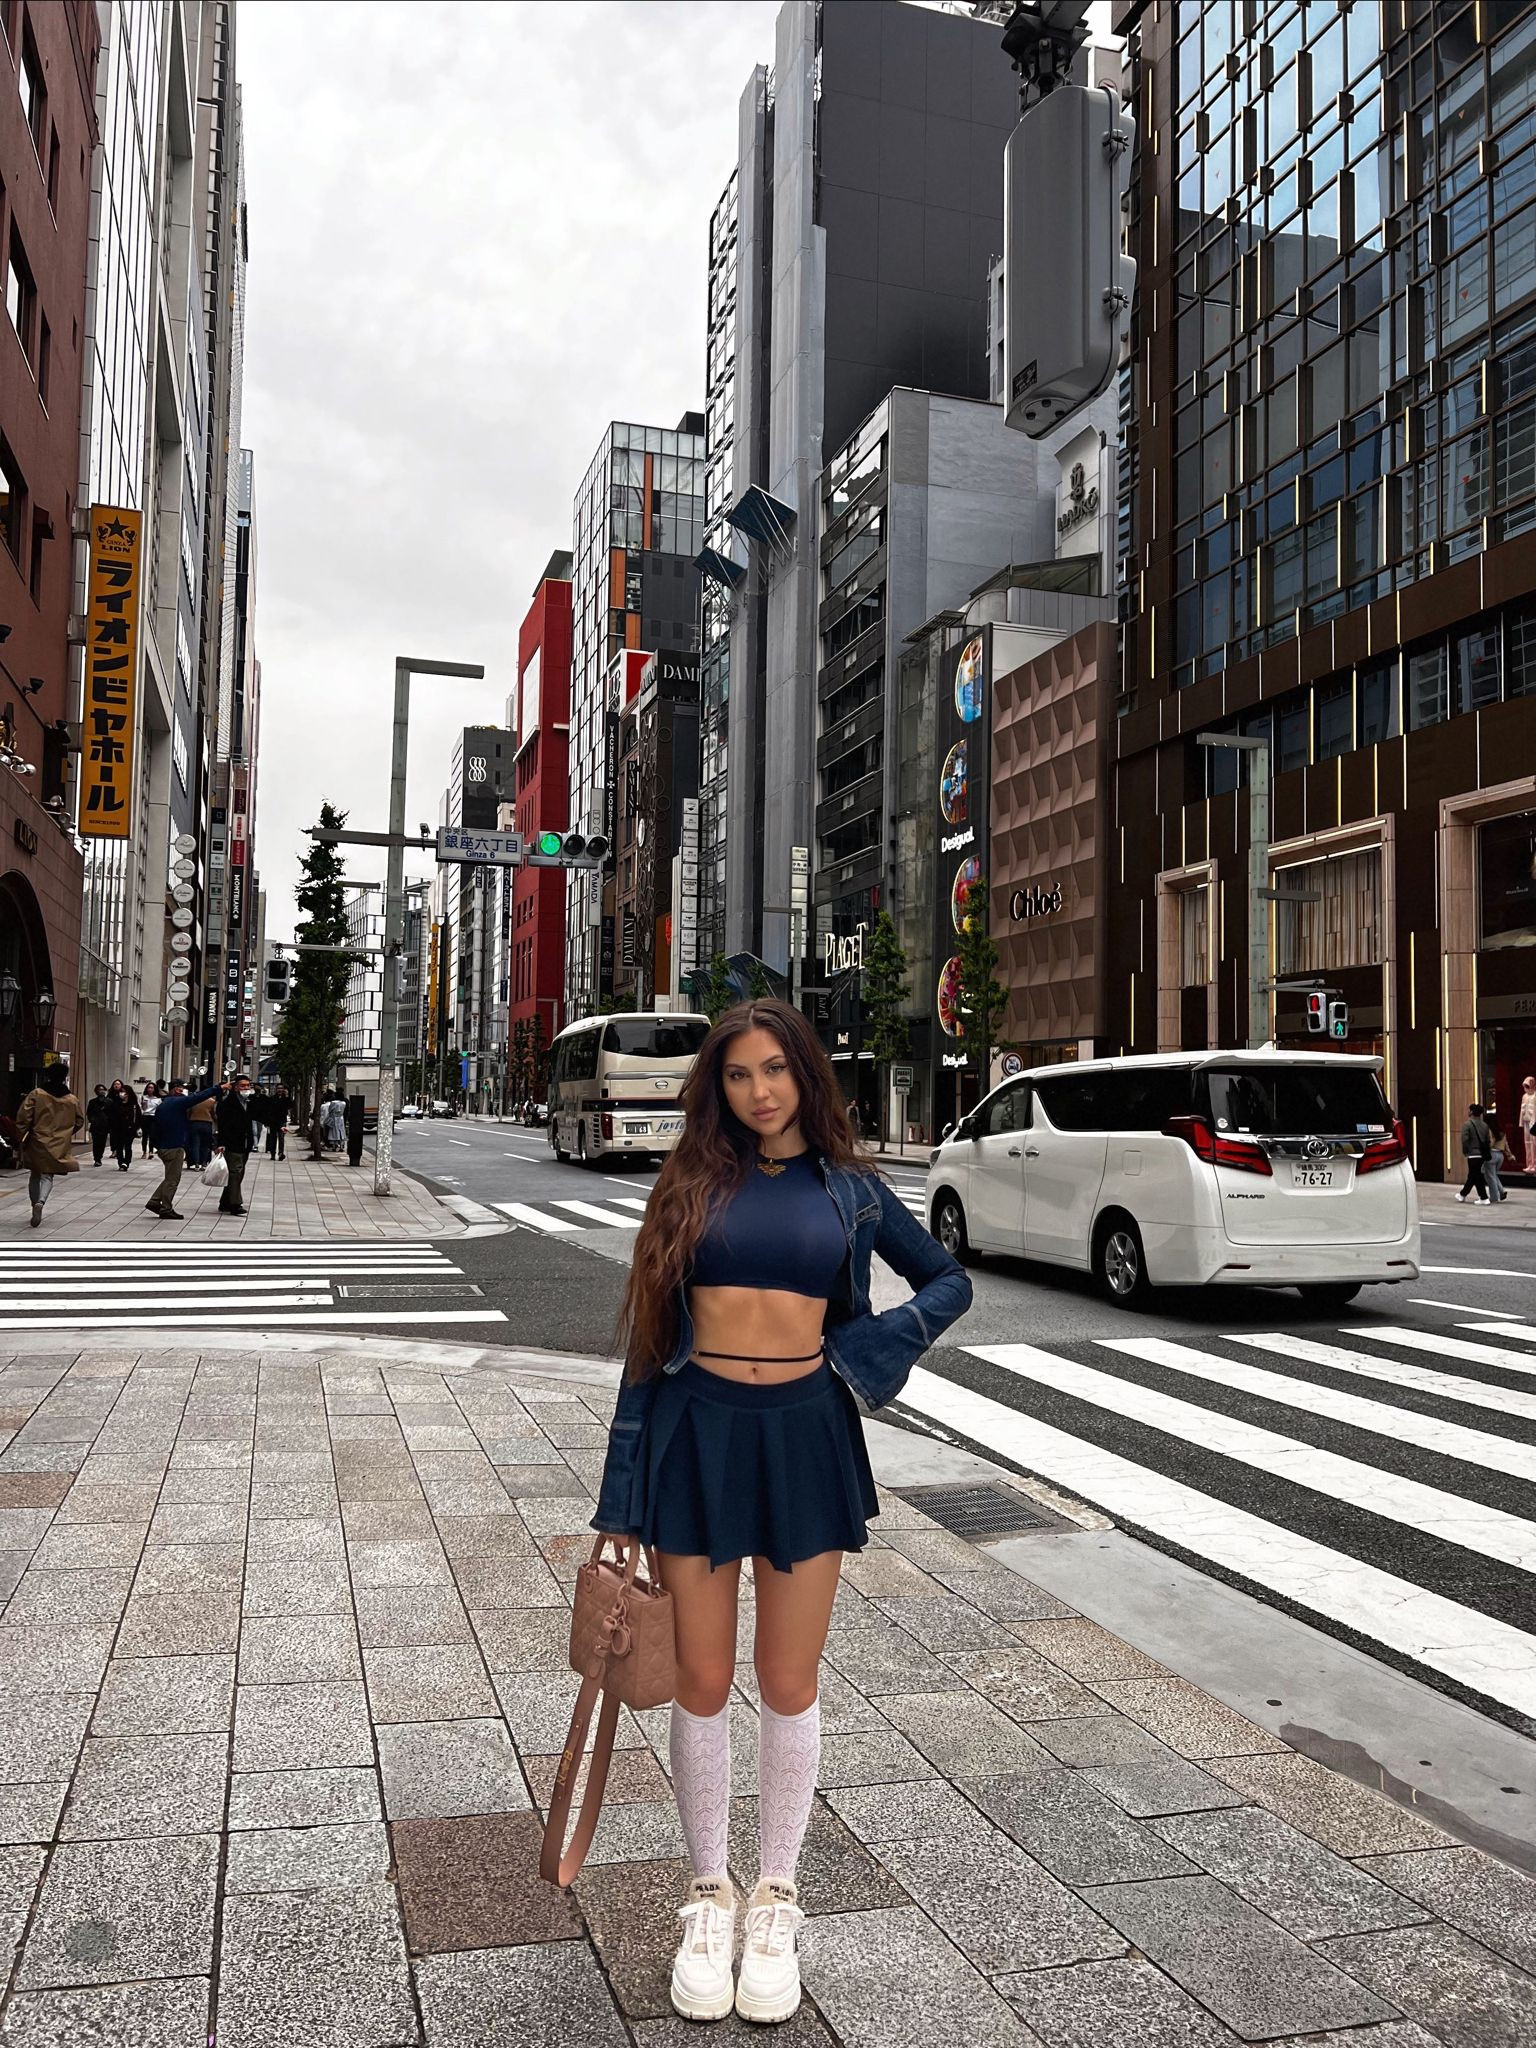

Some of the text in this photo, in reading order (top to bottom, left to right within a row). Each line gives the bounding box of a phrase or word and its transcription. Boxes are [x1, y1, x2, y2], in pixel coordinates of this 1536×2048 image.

[102, 545, 130, 553] LION
[86, 558, 132, 812] ライオンビヤホール
[628, 762, 636, 816] DAMIANI
[444, 828, 468, 836] 中央区
[444, 835, 518, 853] 銀座六丁目
[466, 850, 487, 858] Ginza
[233, 874, 241, 914] MONTBLANC
[591, 873, 600, 904] YAMADA
[1009, 882, 1062, 921] Chloé
[624, 917, 635, 964] DAMIANI
[825, 921, 869, 977] PIAGET
[1301, 1172, 1333, 1185] 76-27
[695, 1884, 720, 1892] PRADA
